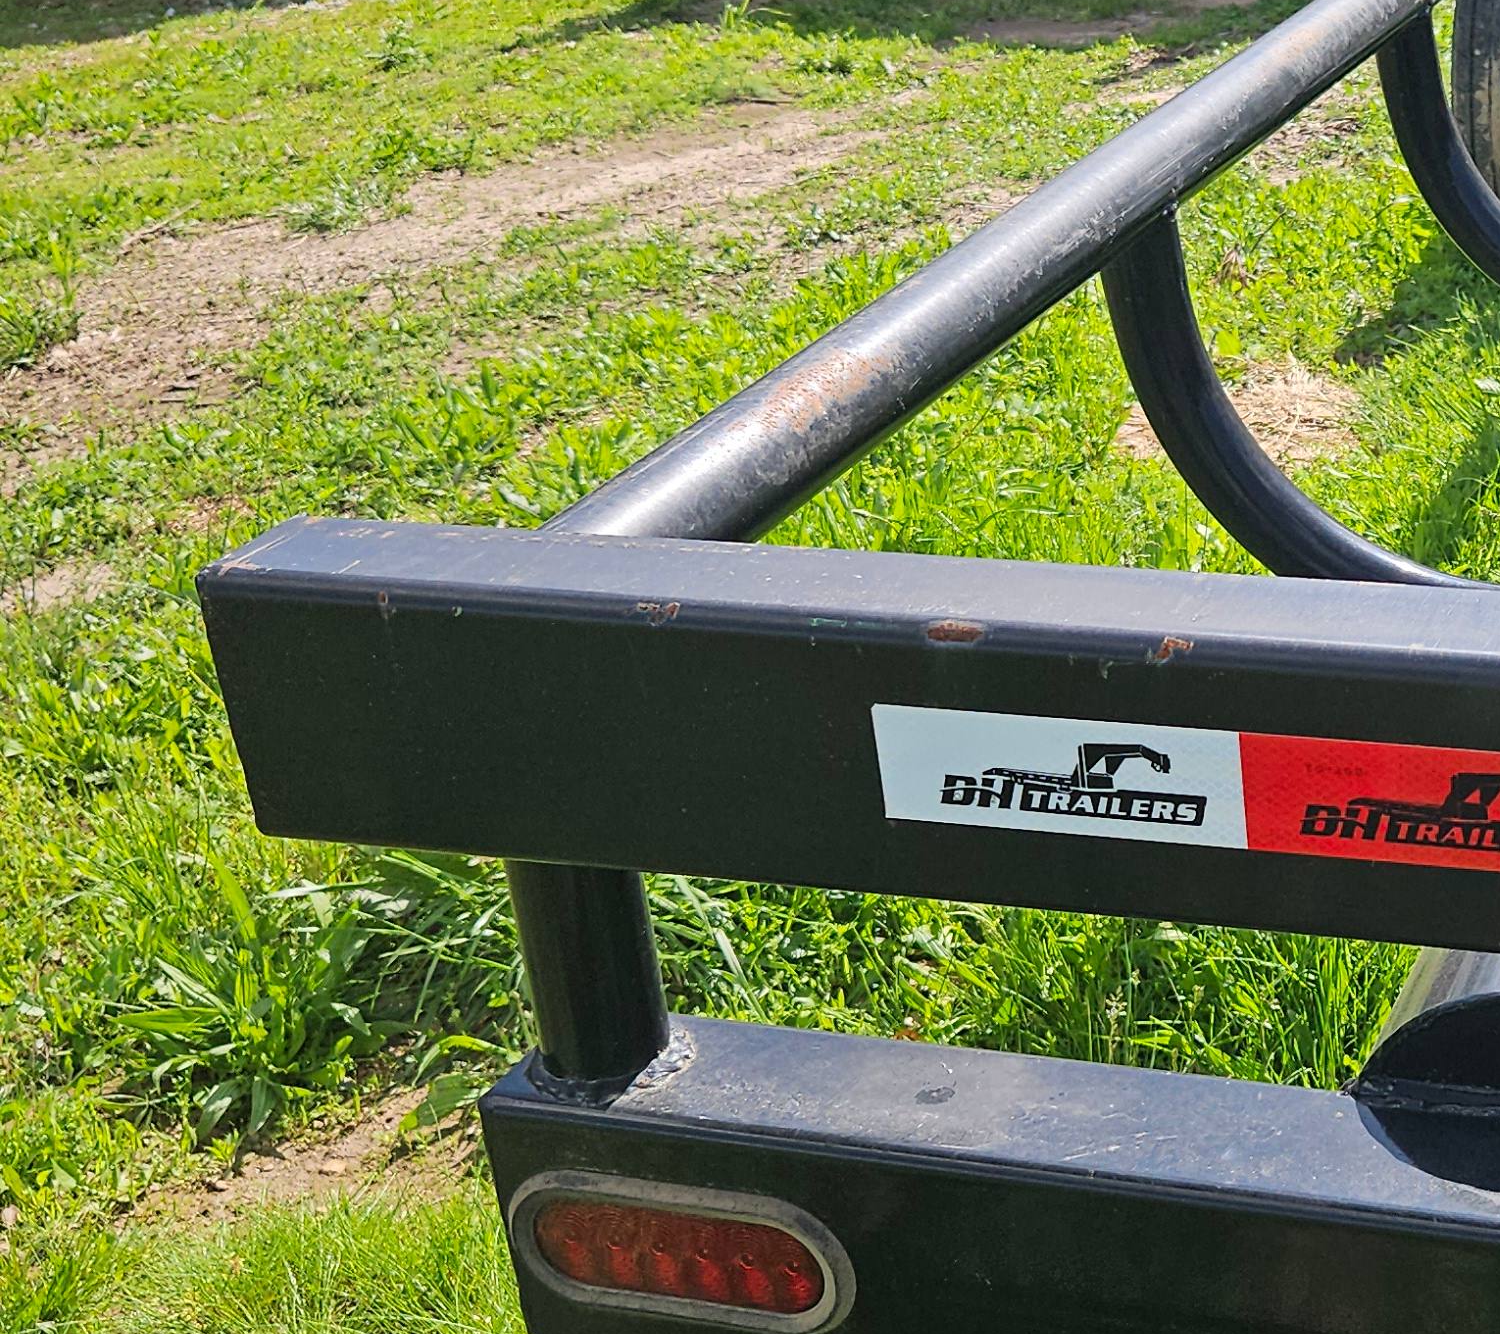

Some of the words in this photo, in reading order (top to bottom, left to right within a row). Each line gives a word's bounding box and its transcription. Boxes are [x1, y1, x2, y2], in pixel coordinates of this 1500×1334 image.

[939, 773, 1018, 809] DH
[1026, 788, 1200, 823] TRAILERS
[1300, 803, 1386, 841] DH
